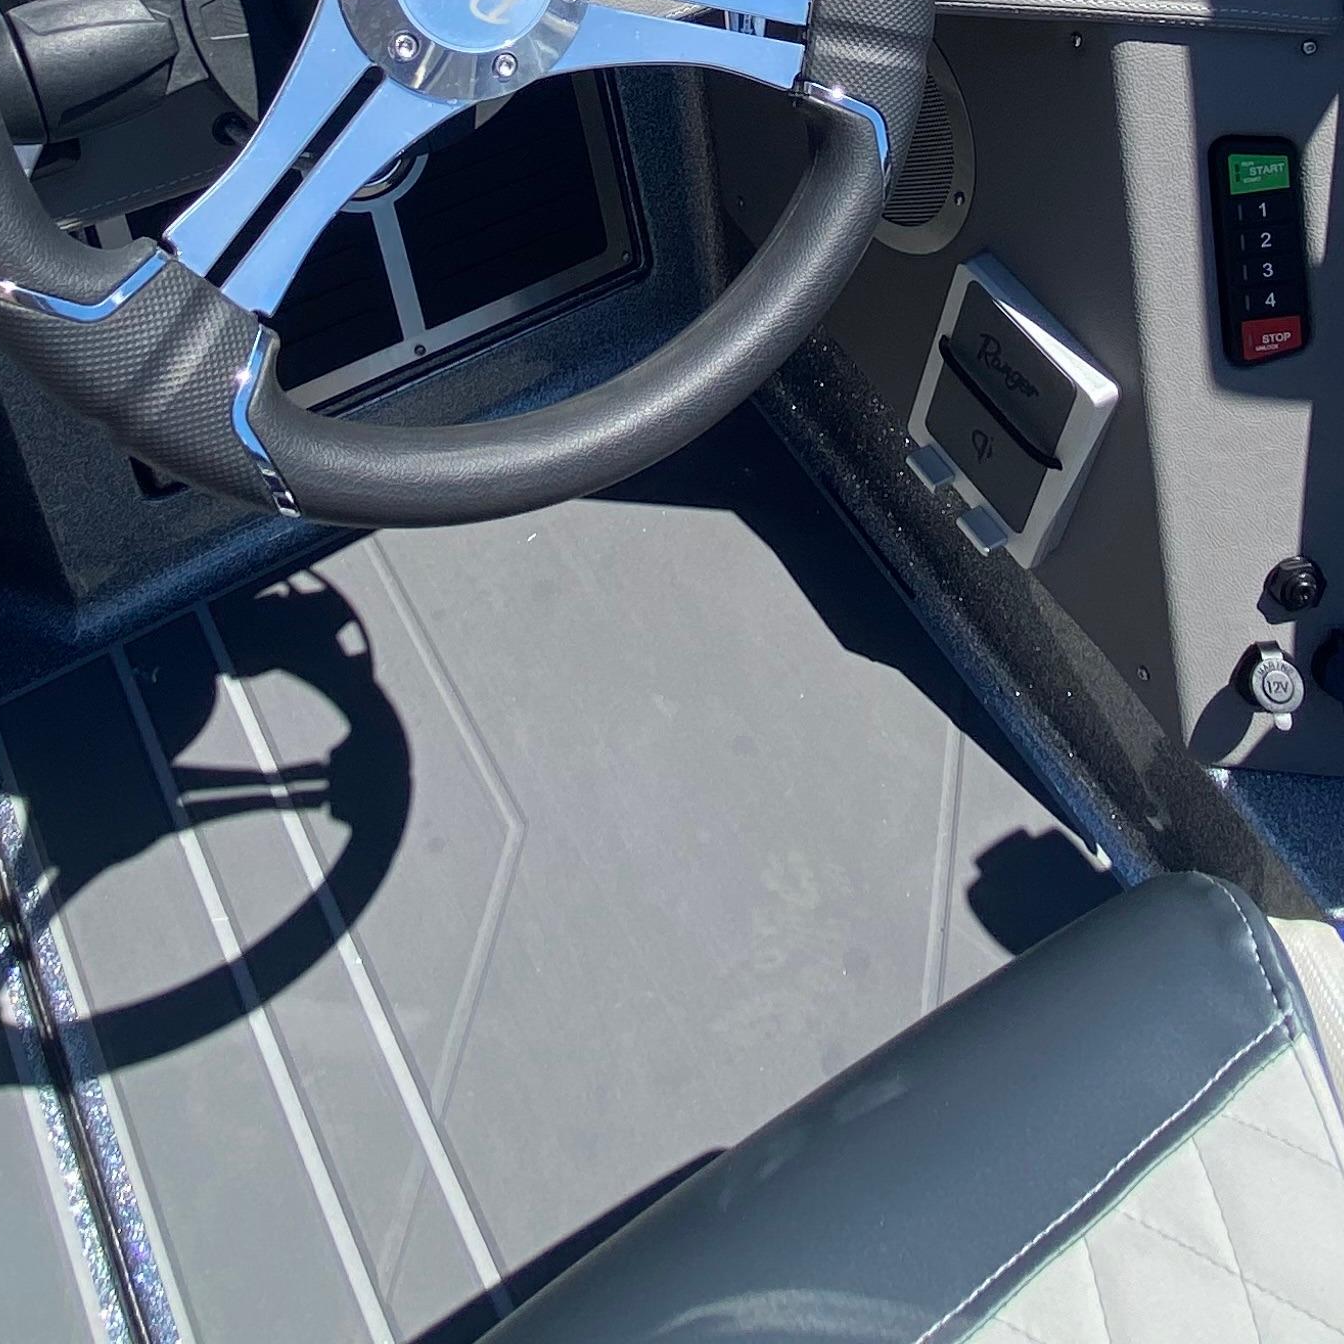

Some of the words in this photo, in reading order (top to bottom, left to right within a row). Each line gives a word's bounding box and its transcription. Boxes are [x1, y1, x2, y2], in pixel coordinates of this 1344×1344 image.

[1249, 162, 1285, 177] START
[1258, 202, 1267, 217] 1
[1260, 232, 1272, 248] 2
[1262, 262, 1274, 278] 3
[1265, 292, 1276, 307] 4
[1262, 331, 1291, 344] STOP
[977, 333, 1040, 398] Ranger
[1266, 680, 1289, 694] 12V
